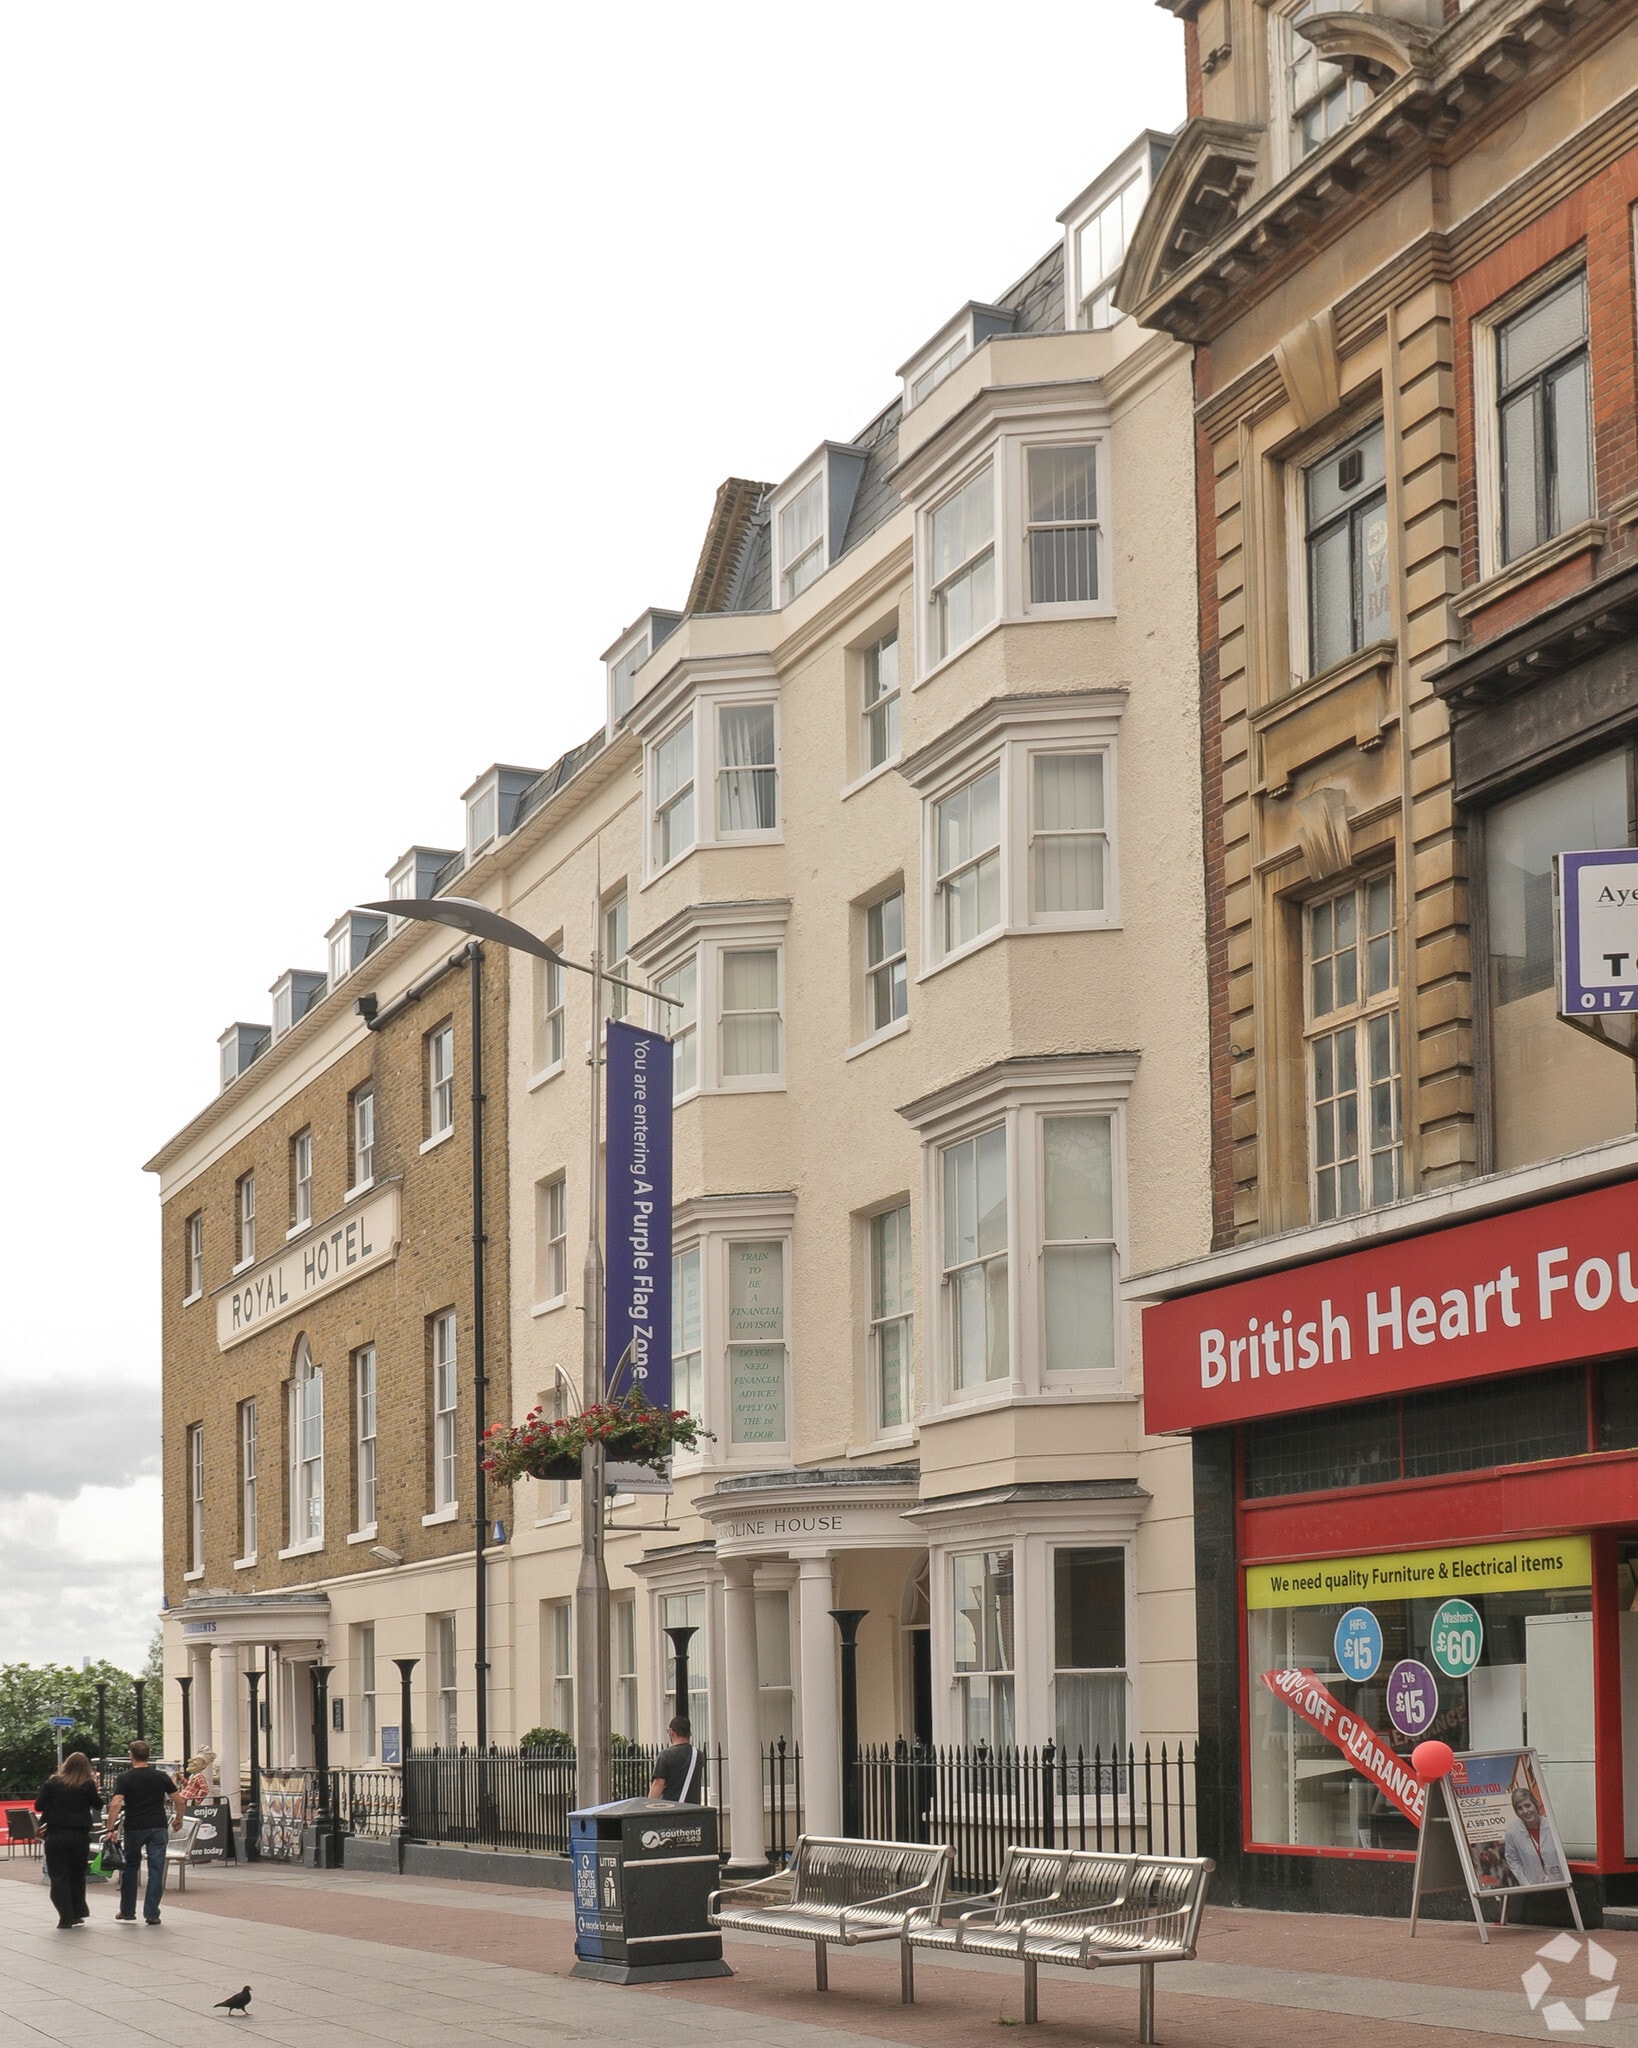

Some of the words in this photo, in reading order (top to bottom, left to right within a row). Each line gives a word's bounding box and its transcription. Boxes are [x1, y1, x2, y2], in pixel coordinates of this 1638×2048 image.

[1603, 952, 1638, 977] T
[1580, 990, 1638, 1009] 017
[634, 1040, 650, 1070] You
[633, 1074, 647, 1100] are
[630, 1104, 650, 1175] entering
[633, 1179, 654, 1195] A
[628, 1201, 654, 1270] Purple
[740, 1253, 769, 1261] TRAIN
[232, 1266, 289, 1331] ROYAL
[304, 1216, 373, 1290] HOTEL
[748, 1266, 761, 1275] TO
[748, 1280, 761, 1288] BE
[628, 1275, 654, 1320] Flag
[731, 1307, 782, 1316] FINANCIAL
[735, 1321, 777, 1329] ADVISOR
[1199, 1299, 1352, 1389] British
[1366, 1265, 1521, 1355] Heart
[632, 1324, 653, 1380] Zone
[739, 1349, 754, 1357] DO
[755, 1349, 773, 1357] YOU
[743, 1362, 769, 1371] NEED
[734, 1376, 782, 1385] FINANCIAL
[738, 1389, 777, 1398] ADVICE?
[735, 1403, 763, 1412] APPLY
[764, 1403, 778, 1411] ON
[743, 1417, 761, 1426] THE
[743, 1431, 774, 1439] FLOOR
[717, 1521, 765, 1539] ROLINE
[774, 1516, 843, 1533] HOUSE
[1270, 1577, 1289, 1592] We
[1292, 1573, 1322, 1590] need
[1325, 1570, 1369, 1592] quality
[1372, 1565, 1435, 1585] Furniture
[1438, 1562, 1449, 1579] &
[1452, 1556, 1517, 1578] Electrical
[1521, 1555, 1563, 1572] items
[1442, 1612, 1474, 1624] Washers
[1349, 1619, 1367, 1631] HiFis
[1436, 1630, 1476, 1665] £60
[1344, 1637, 1372, 1670] £15
[1400, 1671, 1416, 1684] TVs
[1395, 1690, 1426, 1724] £15
[1275, 1668, 1310, 1705] 50%
[1305, 1690, 1337, 1727] OFF
[1337, 1715, 1426, 1817] CLEARANCE
[1454, 1785, 1483, 1795] THANK
[1484, 1783, 1502, 1793] YOU
[1460, 1798, 1487, 1807] ESSEX
[194, 1807, 218, 1818] enjoy
[660, 1828, 701, 1838] southend
[204, 1847, 224, 1856] today
[600, 1857, 617, 1867] LITTER
[577, 1869, 595, 1879] PLASTIC
[582, 1879, 596, 1888] GLASS
[577, 1888, 597, 1897] BOTTLES
[581, 1898, 594, 1907] CANS
